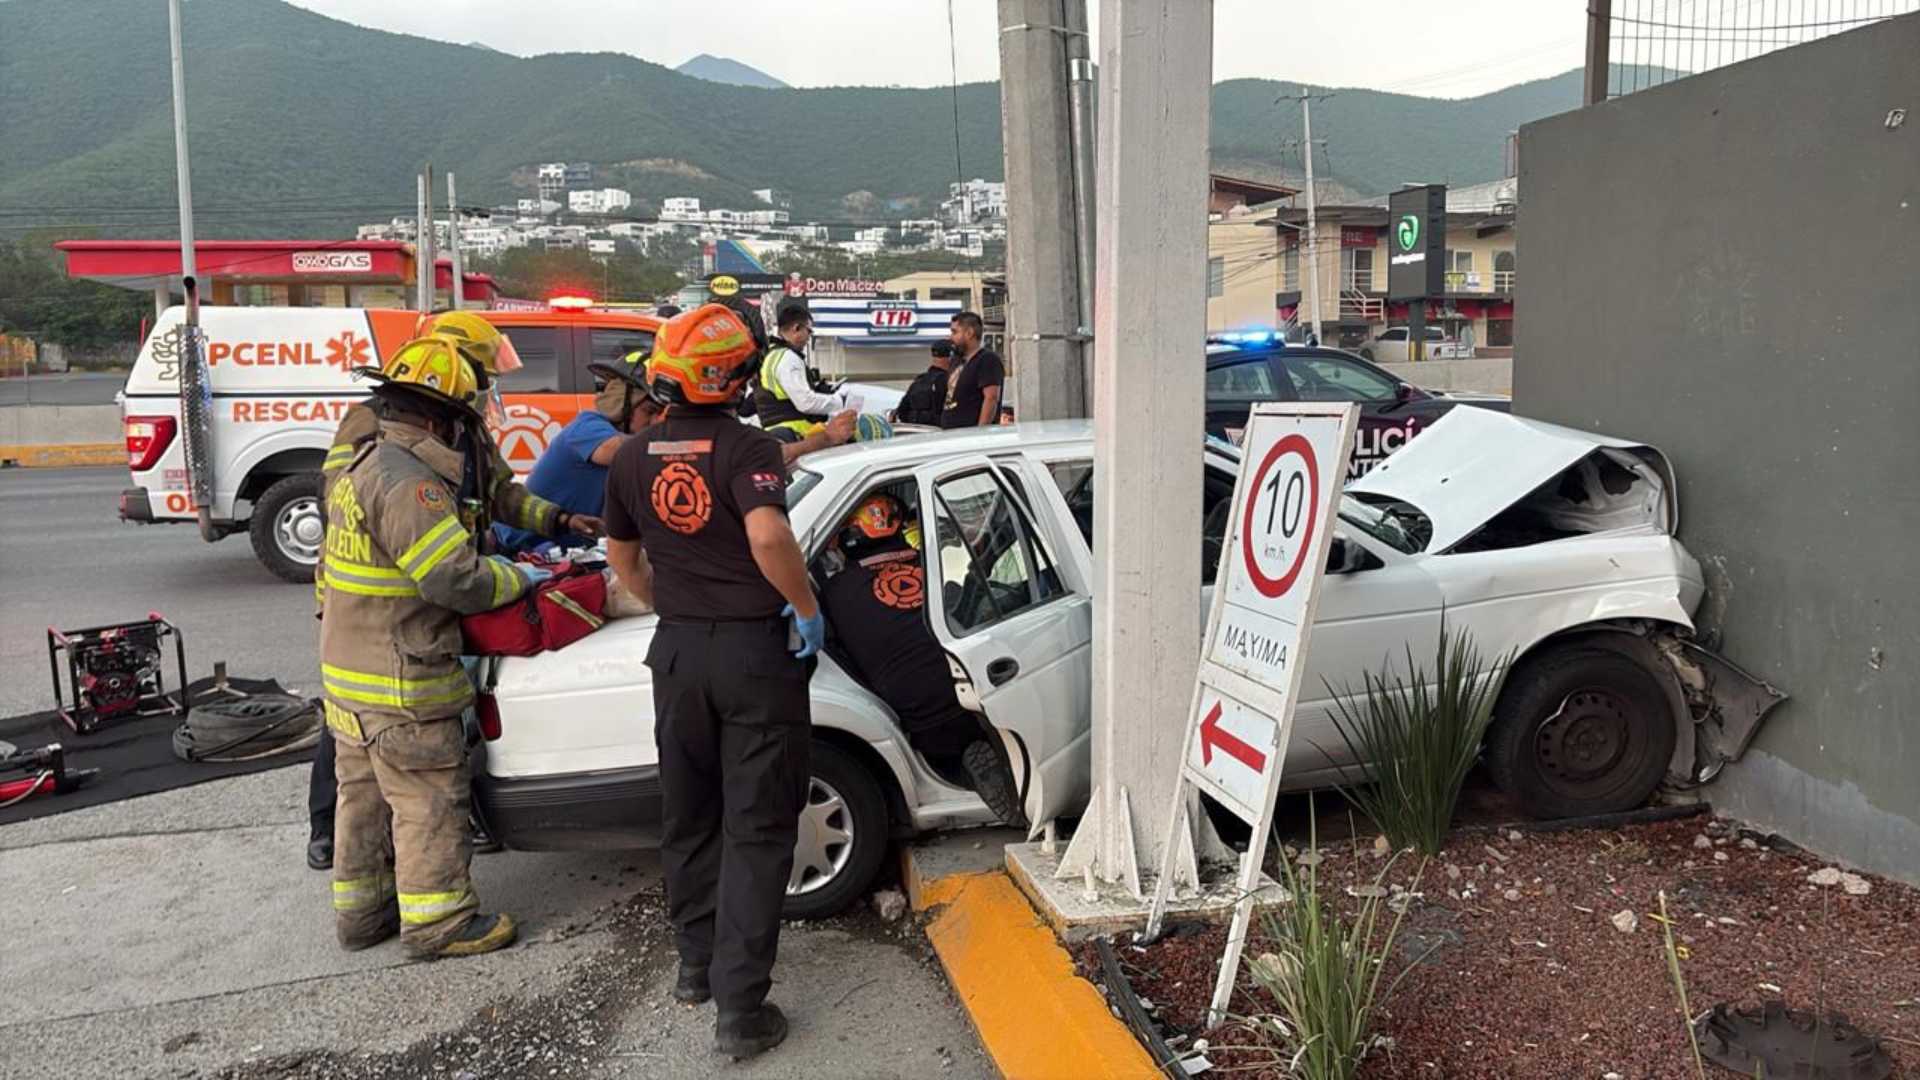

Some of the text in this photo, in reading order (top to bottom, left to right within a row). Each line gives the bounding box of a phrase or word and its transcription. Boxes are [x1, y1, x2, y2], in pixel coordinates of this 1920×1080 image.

[806, 277, 836, 293] Don
[875, 311, 912, 325] LTH
[208, 342, 323, 367] PCENL
[232, 401, 358, 423] RESCAT
[1267, 470, 1304, 538] 10
